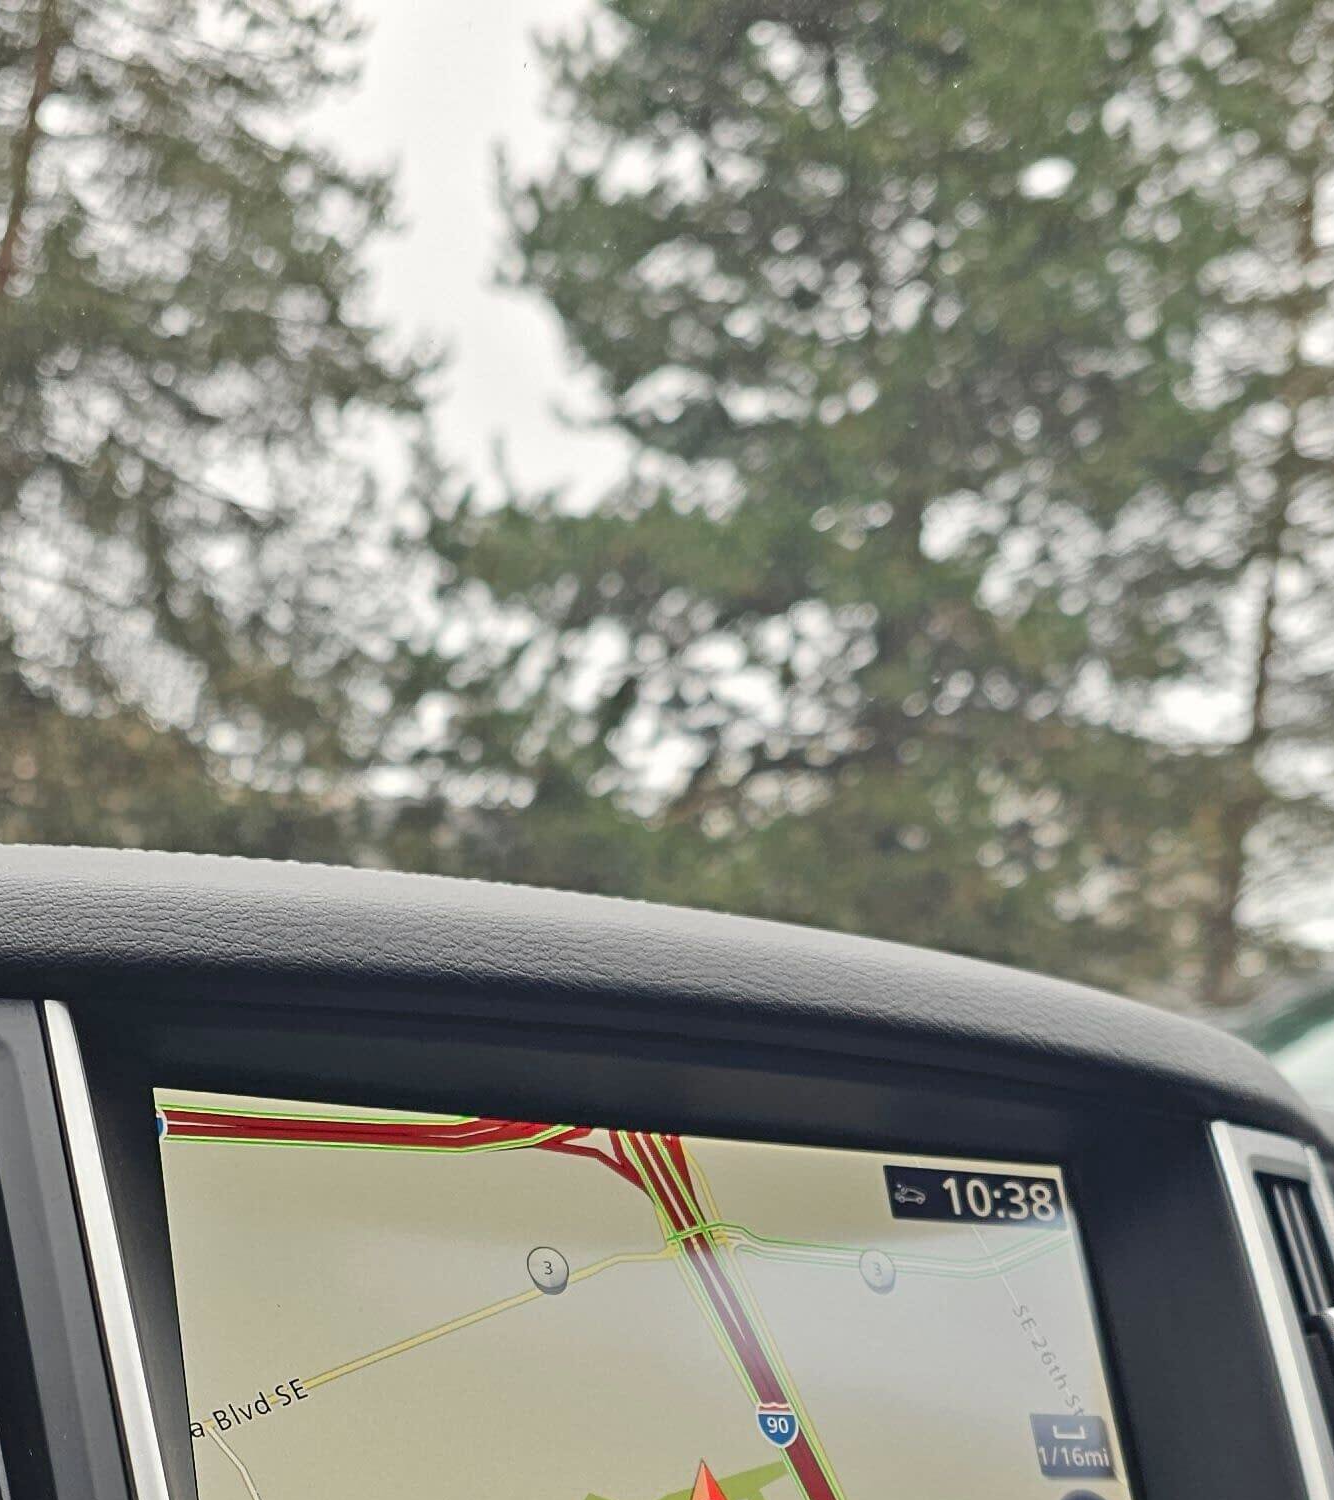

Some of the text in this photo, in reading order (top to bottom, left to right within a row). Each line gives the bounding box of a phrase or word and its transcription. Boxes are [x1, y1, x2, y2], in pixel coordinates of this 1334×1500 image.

[942, 1177, 1058, 1221] 10:38
[543, 1260, 554, 1276] 3
[212, 1391, 272, 1431] Blvd
[274, 1378, 309, 1406] SE
[766, 1416, 790, 1434] 90
[1037, 1446, 1110, 1469] 1/16mi
